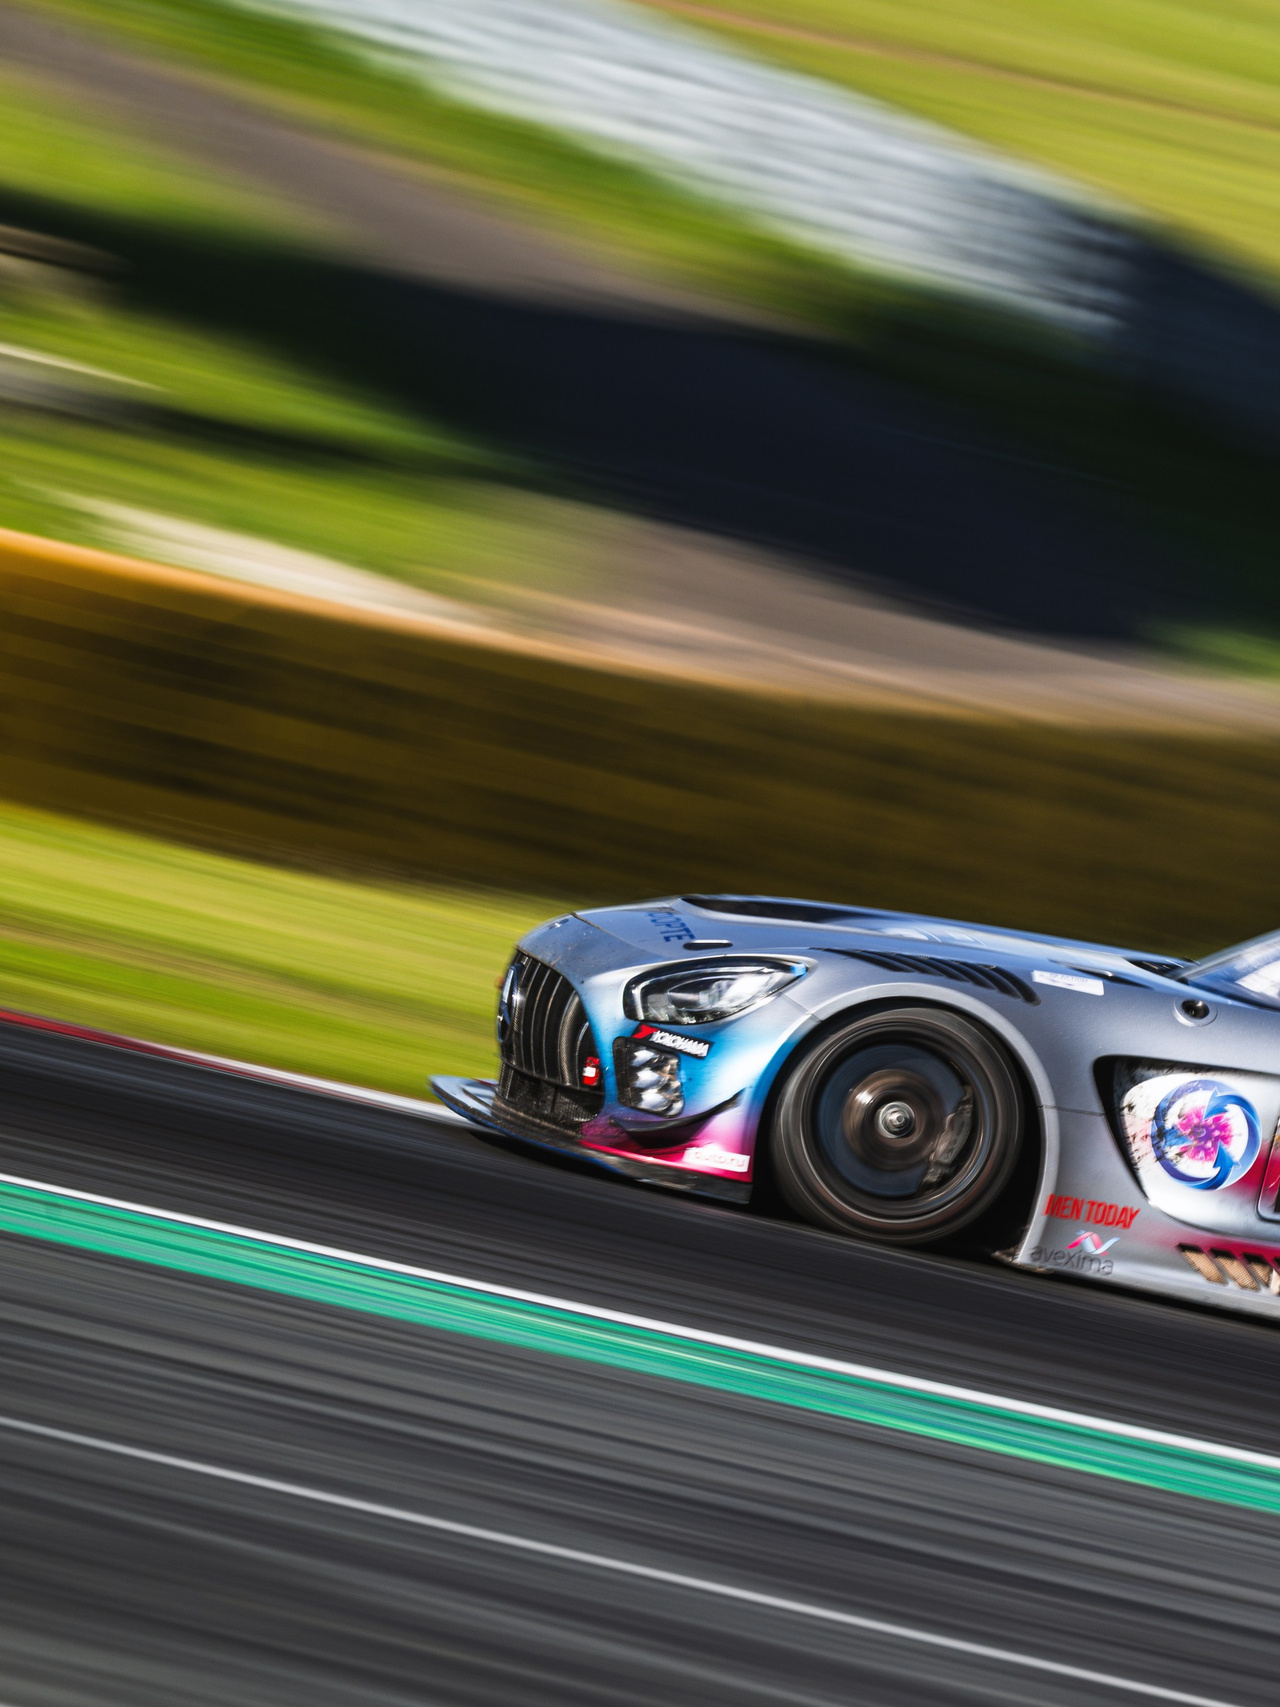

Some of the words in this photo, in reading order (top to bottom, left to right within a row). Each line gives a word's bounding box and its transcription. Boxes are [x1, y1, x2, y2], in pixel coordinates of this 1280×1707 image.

[650, 1030, 709, 1057] YOKOHAMA
[1043, 1193, 1084, 1221] MEN
[1083, 1200, 1141, 1230] TODAY
[1029, 1245, 1114, 1276] avexima
